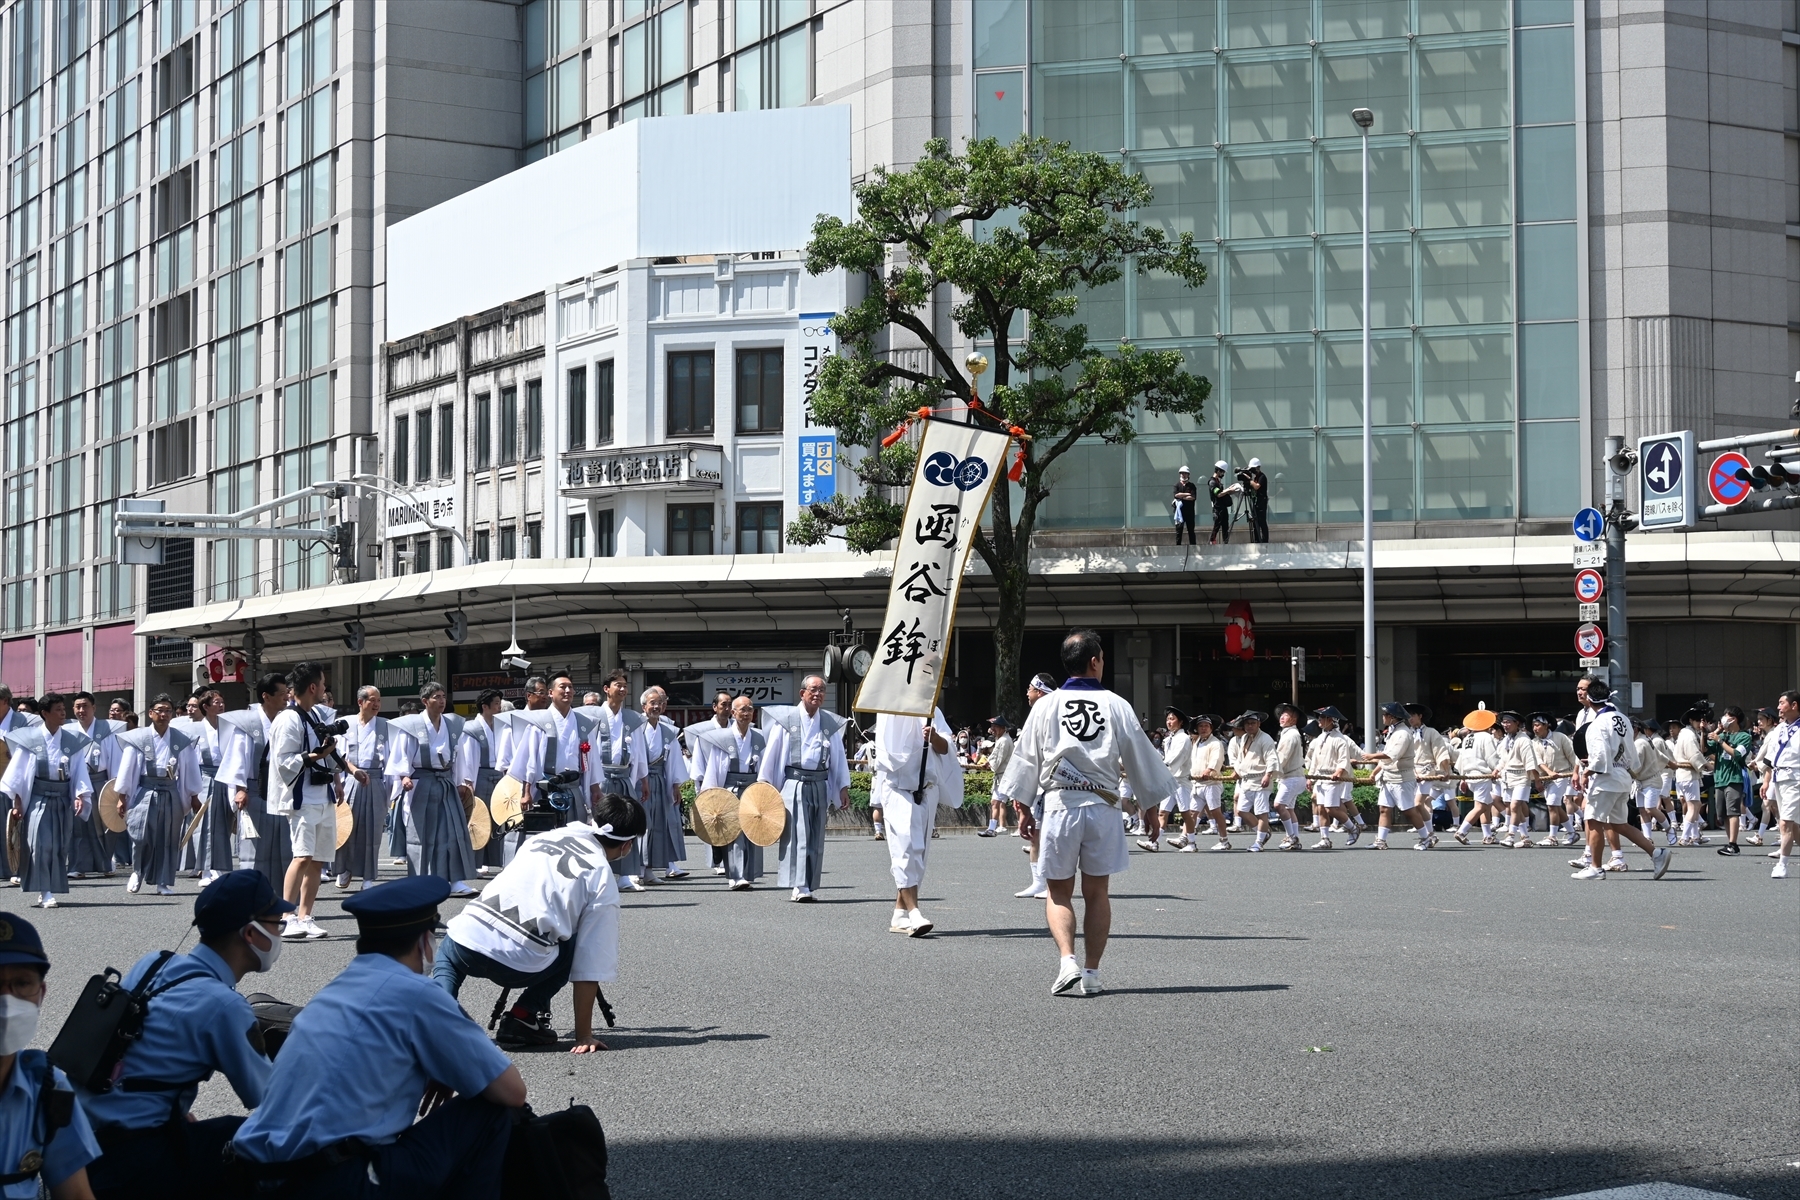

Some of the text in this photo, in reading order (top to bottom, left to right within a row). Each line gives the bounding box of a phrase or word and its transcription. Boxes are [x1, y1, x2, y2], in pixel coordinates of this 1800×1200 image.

[567, 454, 681, 485] 池善化粧品店
[818, 443, 831, 475] すぐ
[802, 442, 816, 503] 買えます
[433, 496, 454, 520] 雲の茶
[1644, 501, 1683, 516] 路線バスを除く
[374, 666, 414, 688] MARUMARU
[737, 676, 783, 684] メガネスーパー
